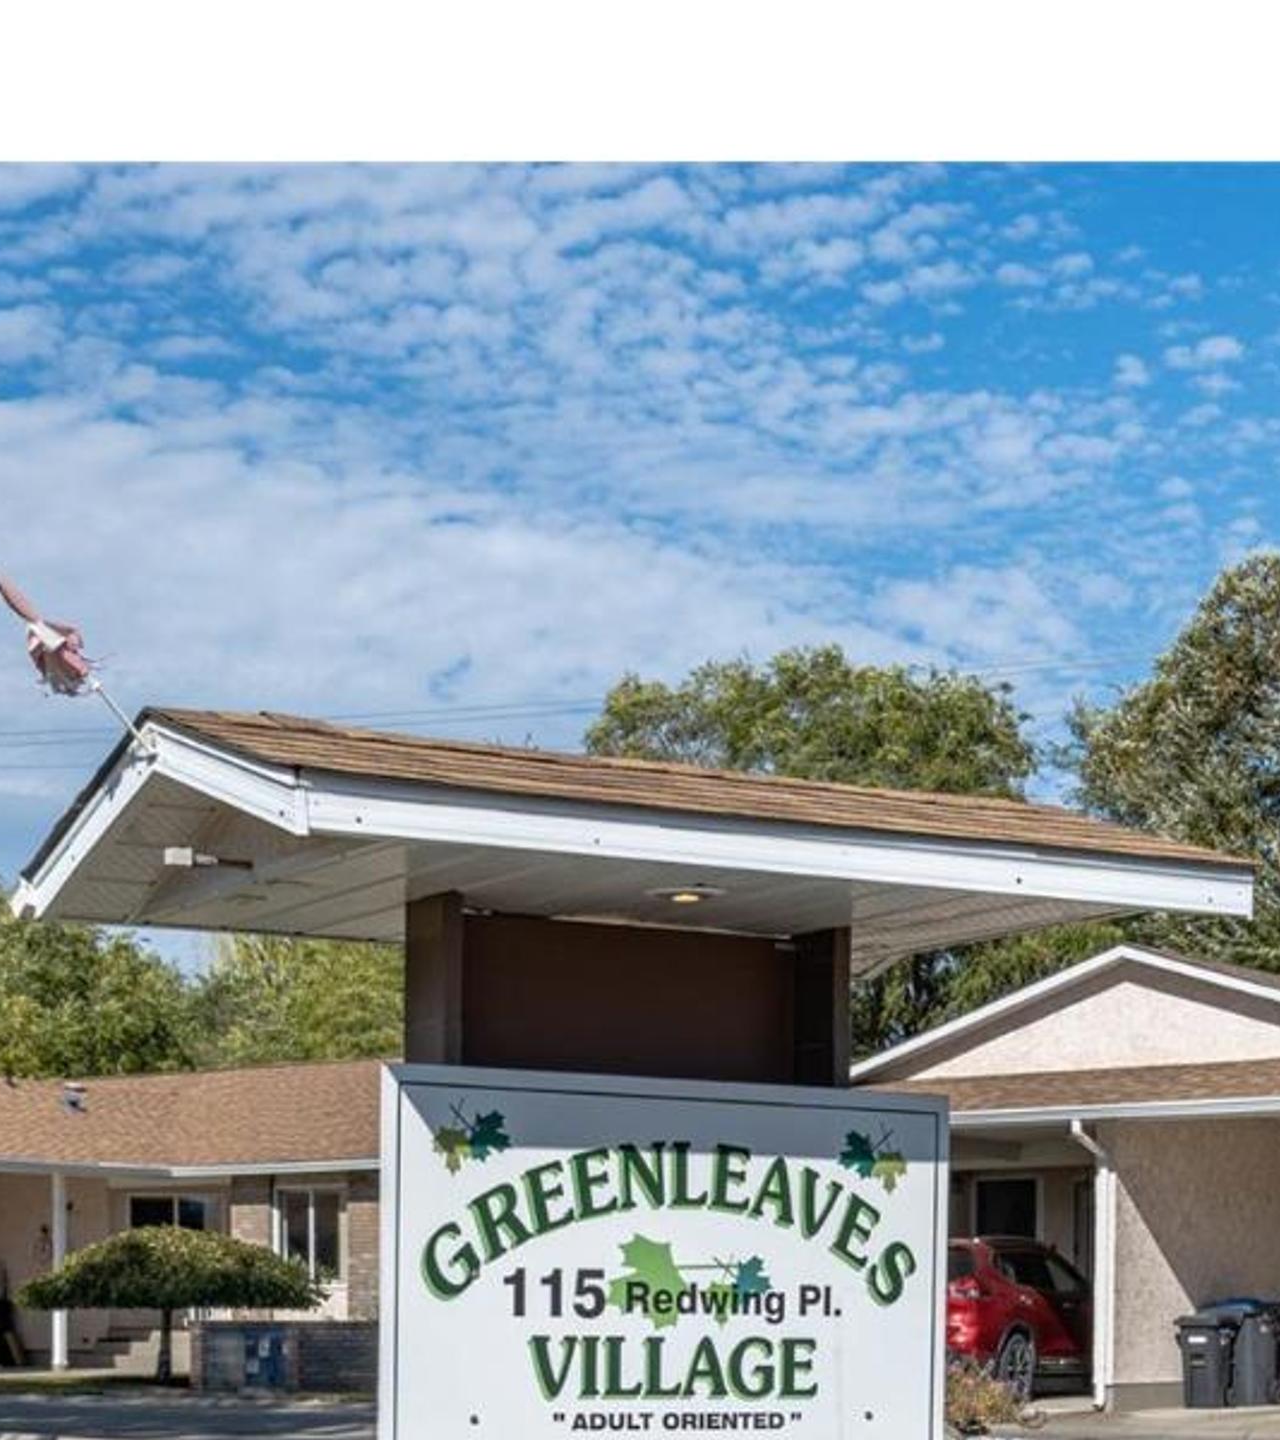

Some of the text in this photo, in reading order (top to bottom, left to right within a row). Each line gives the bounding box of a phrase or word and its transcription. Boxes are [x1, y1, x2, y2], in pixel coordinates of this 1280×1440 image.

[421, 1140, 917, 1308] GREENLEAVES
[503, 1267, 842, 1324] 115 Redwing Pl.
[528, 1334, 818, 1401] VILLAGE
